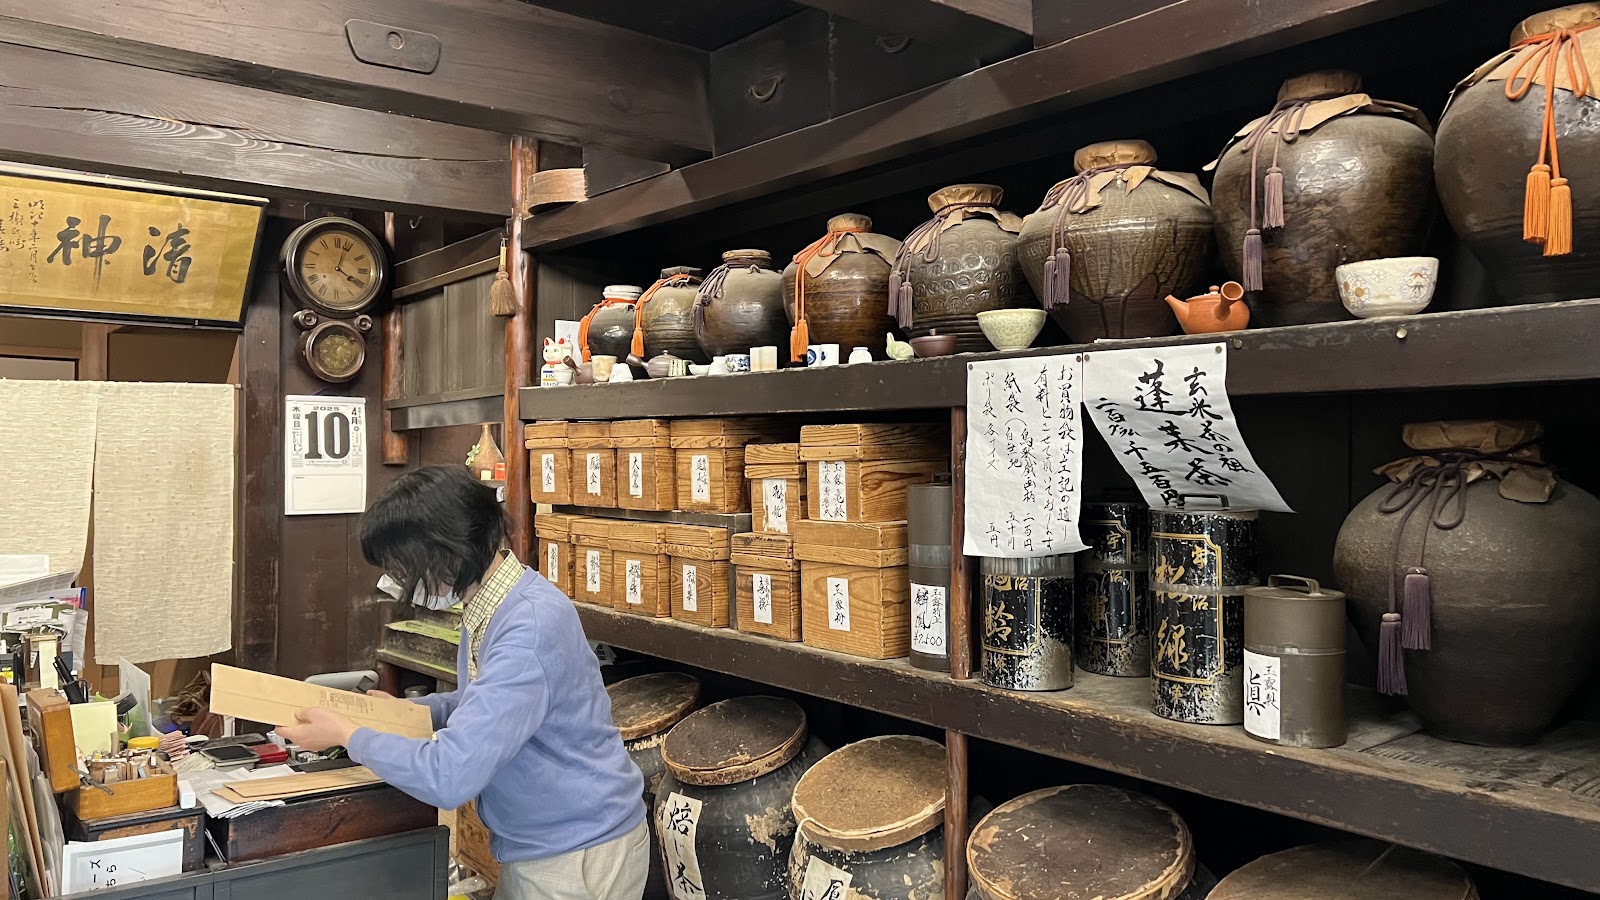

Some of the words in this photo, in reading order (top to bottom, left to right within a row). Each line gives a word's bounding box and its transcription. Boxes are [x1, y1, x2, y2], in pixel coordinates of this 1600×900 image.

[293, 406, 301, 427] 木曜日
[305, 411, 350, 459] 10
[352, 406, 358, 424] 4月
[1133, 358, 1234, 487] 蓬莱茶
[1183, 366, 1256, 474] 玄米茶の祖
[985, 521, 1001, 549] 五円
[666, 799, 703, 895] 焙じ茶
